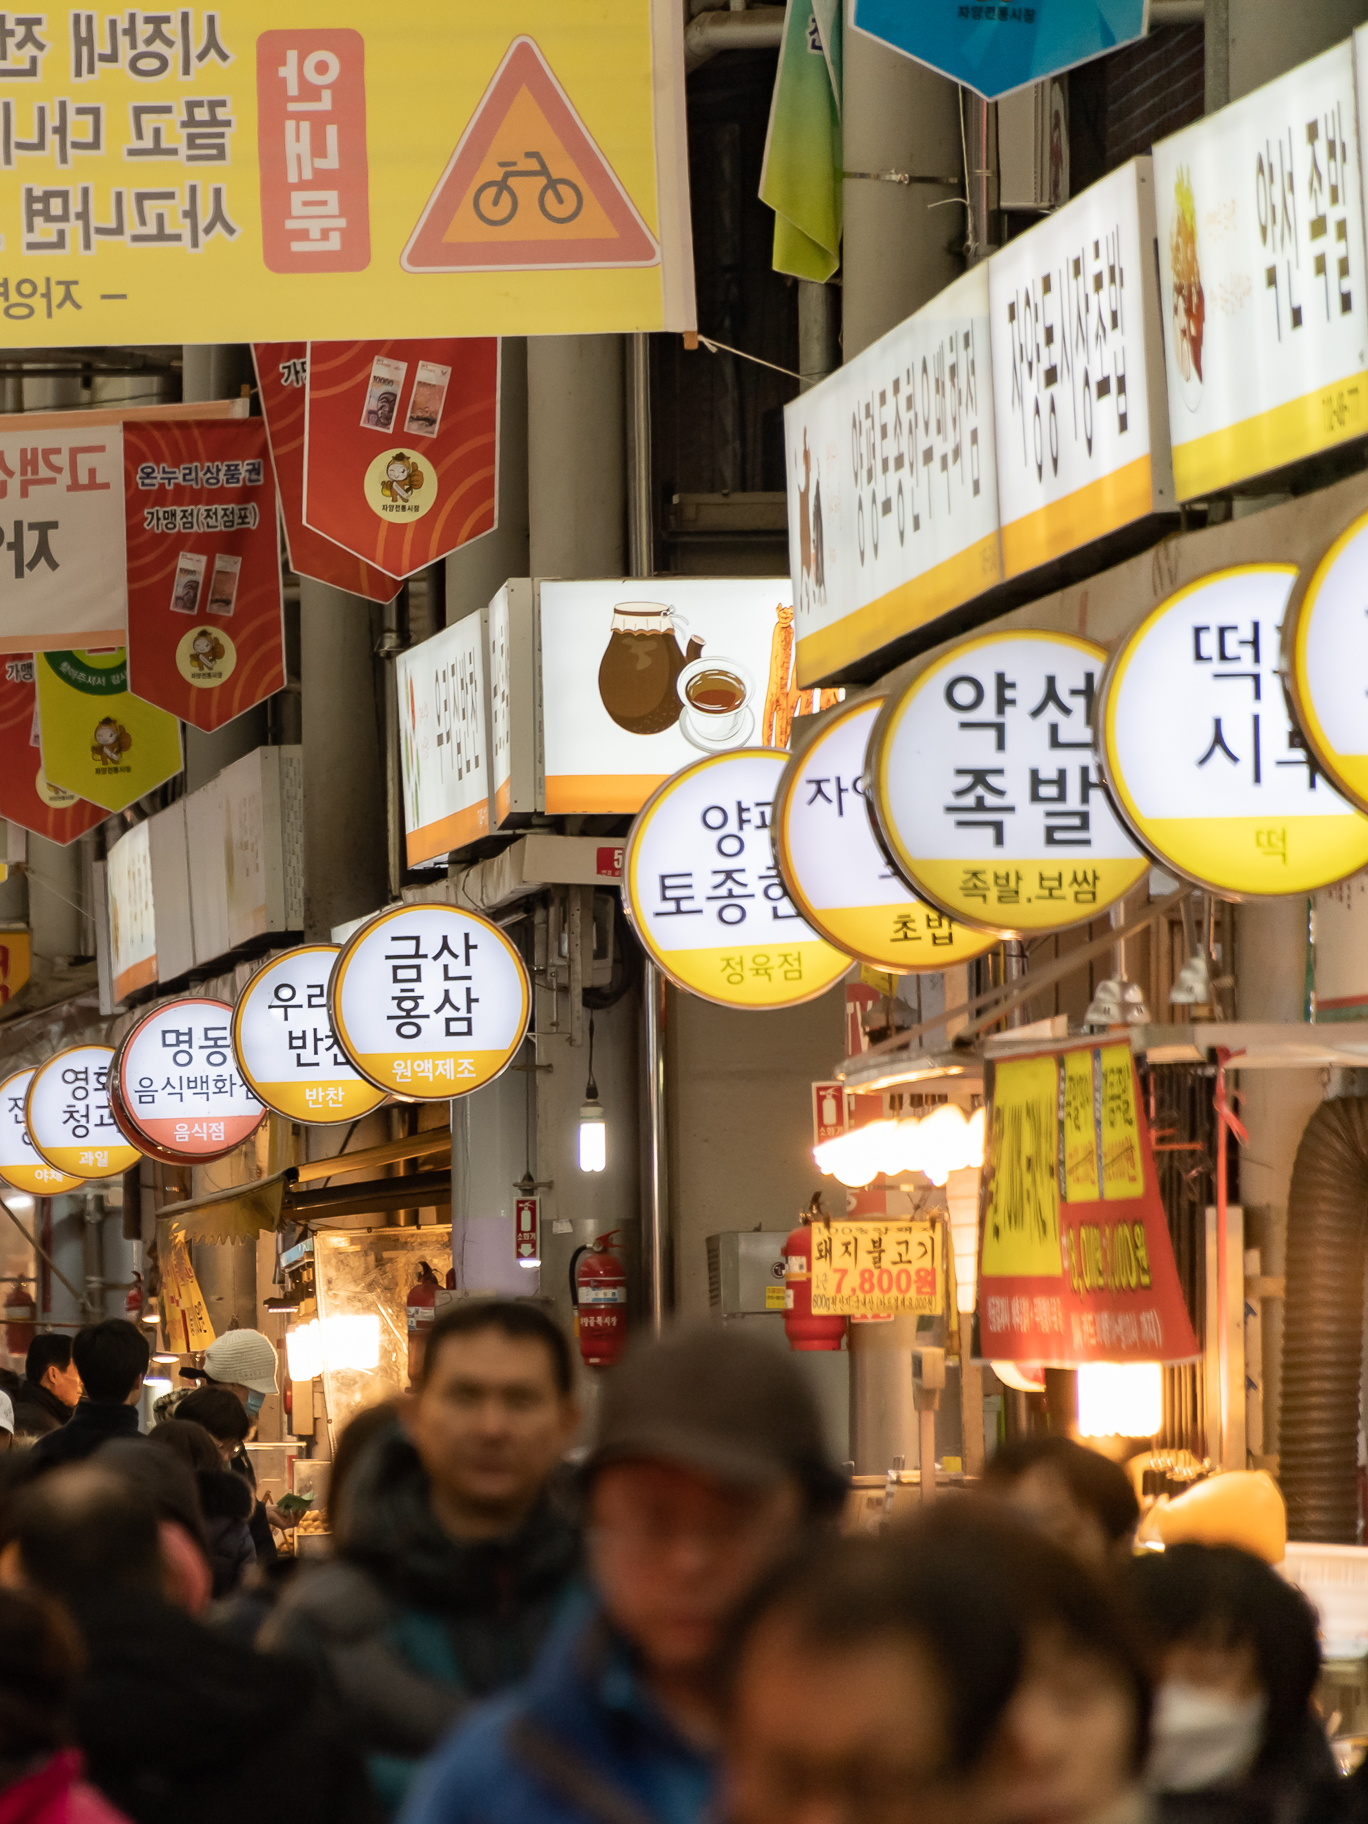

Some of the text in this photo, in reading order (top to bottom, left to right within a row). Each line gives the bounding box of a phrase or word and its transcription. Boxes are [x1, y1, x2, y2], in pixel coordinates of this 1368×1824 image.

[137, 459, 264, 490] 온누리상품권
[945, 671, 1096, 752] 약선
[944, 766, 1107, 848] 족발
[1255, 828, 1288, 866] 떡
[889, 913, 955, 946] 초밥
[384, 932, 479, 984] 금산
[720, 951, 803, 985] 정육점
[385, 986, 480, 1040] 홍삼
[161, 1027, 231, 1067] 명동
[391, 1059, 477, 1083] 원액제조
[305, 1087, 345, 1108] 반찬
[173, 1122, 225, 1143] 음식점
[34, 1168, 64, 1183] 야채
[79, 1150, 109, 1168] 과일
[815, 1235, 935, 1270] 돼지불고기
[832, 1267, 937, 1296] 7,800원
